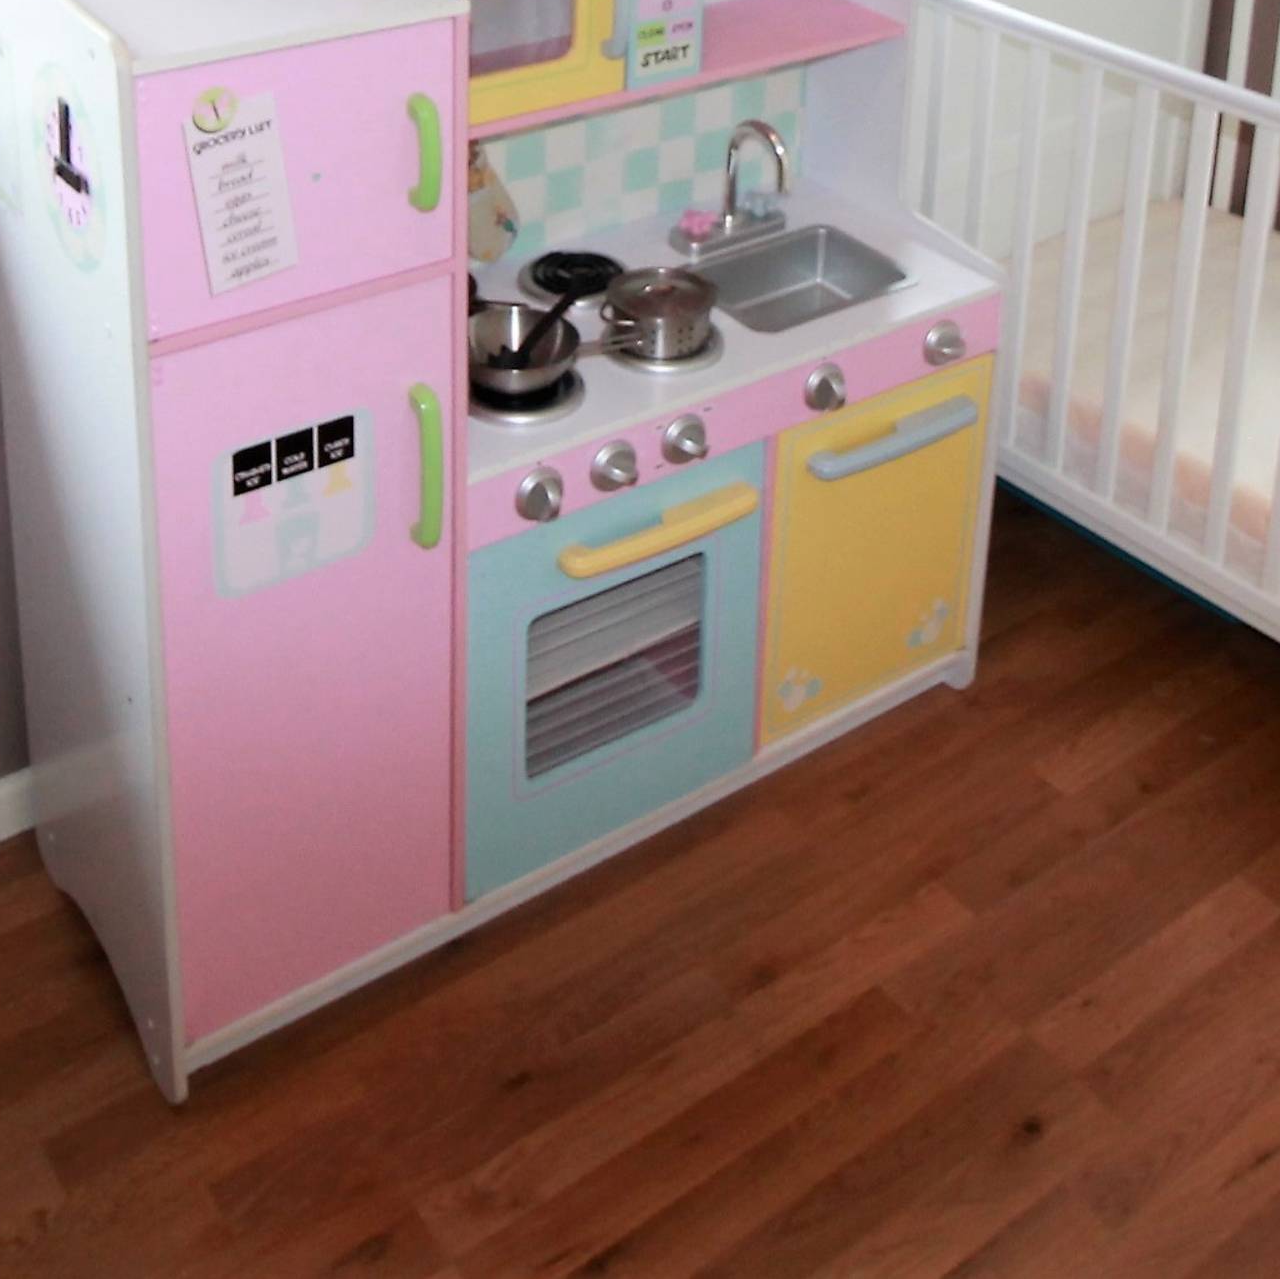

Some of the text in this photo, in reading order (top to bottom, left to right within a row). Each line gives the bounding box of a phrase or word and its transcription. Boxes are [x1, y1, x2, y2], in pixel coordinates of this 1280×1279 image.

[641, 44, 690, 68] START
[192, 119, 272, 155] GROCERY LIST
